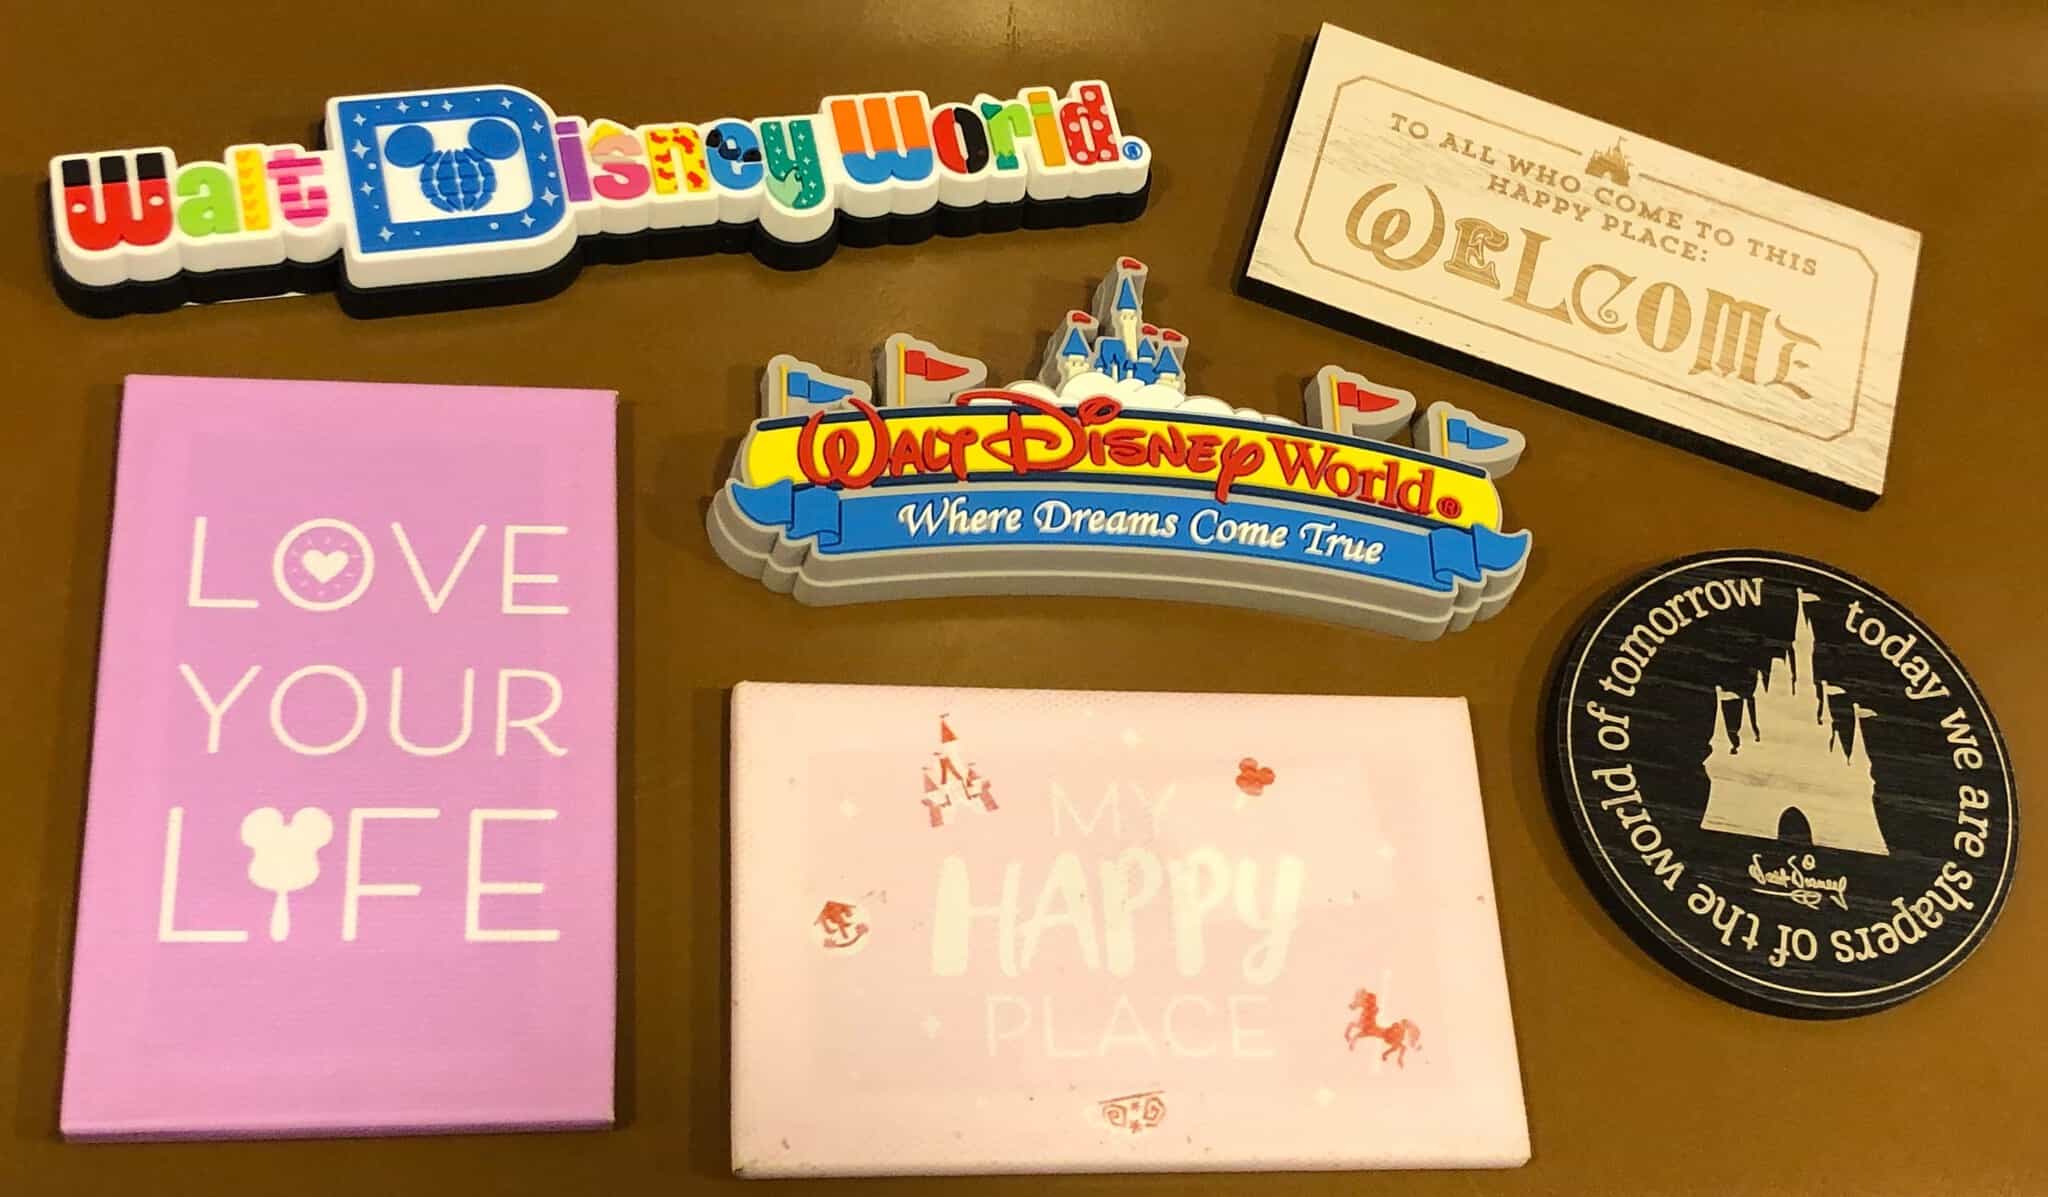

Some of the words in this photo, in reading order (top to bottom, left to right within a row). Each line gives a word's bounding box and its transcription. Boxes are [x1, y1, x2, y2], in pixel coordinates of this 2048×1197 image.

[62, 149, 329, 251] Walt
[338, 88, 826, 253] Disney
[1390, 113, 1429, 140] TO
[1440, 132, 1495, 165] ALL
[1508, 154, 1581, 193] WHO
[1593, 188, 1681, 231] COME
[1696, 219, 1735, 247] TO
[1748, 237, 1817, 276] THIS
[1488, 175, 1592, 223] HAPPY
[1601, 215, 1708, 263] PLACE:
[1345, 183, 1822, 399] WELCOME
[189, 516, 569, 614] LOVE
[898, 499, 1022, 544] Where
[1035, 501, 1178, 540] Dreams
[1189, 509, 1289, 550] Come
[1299, 521, 1384, 564] True
[1598, 577, 1764, 697] tomorrow
[1844, 600, 1950, 700] today
[179, 663, 568, 756] YOUR
[1587, 701, 1630, 751] of
[1940, 707, 1983, 770] we
[1050, 782, 1176, 835] MY
[1592, 764, 1686, 891] world
[1954, 785, 1989, 857] are
[931, 846, 1304, 984] HAPPY
[1687, 884, 1760, 950] the
[1769, 925, 1817, 967] of
[1835, 862, 1975, 963] shapers
[987, 994, 1276, 1058] PLACE
